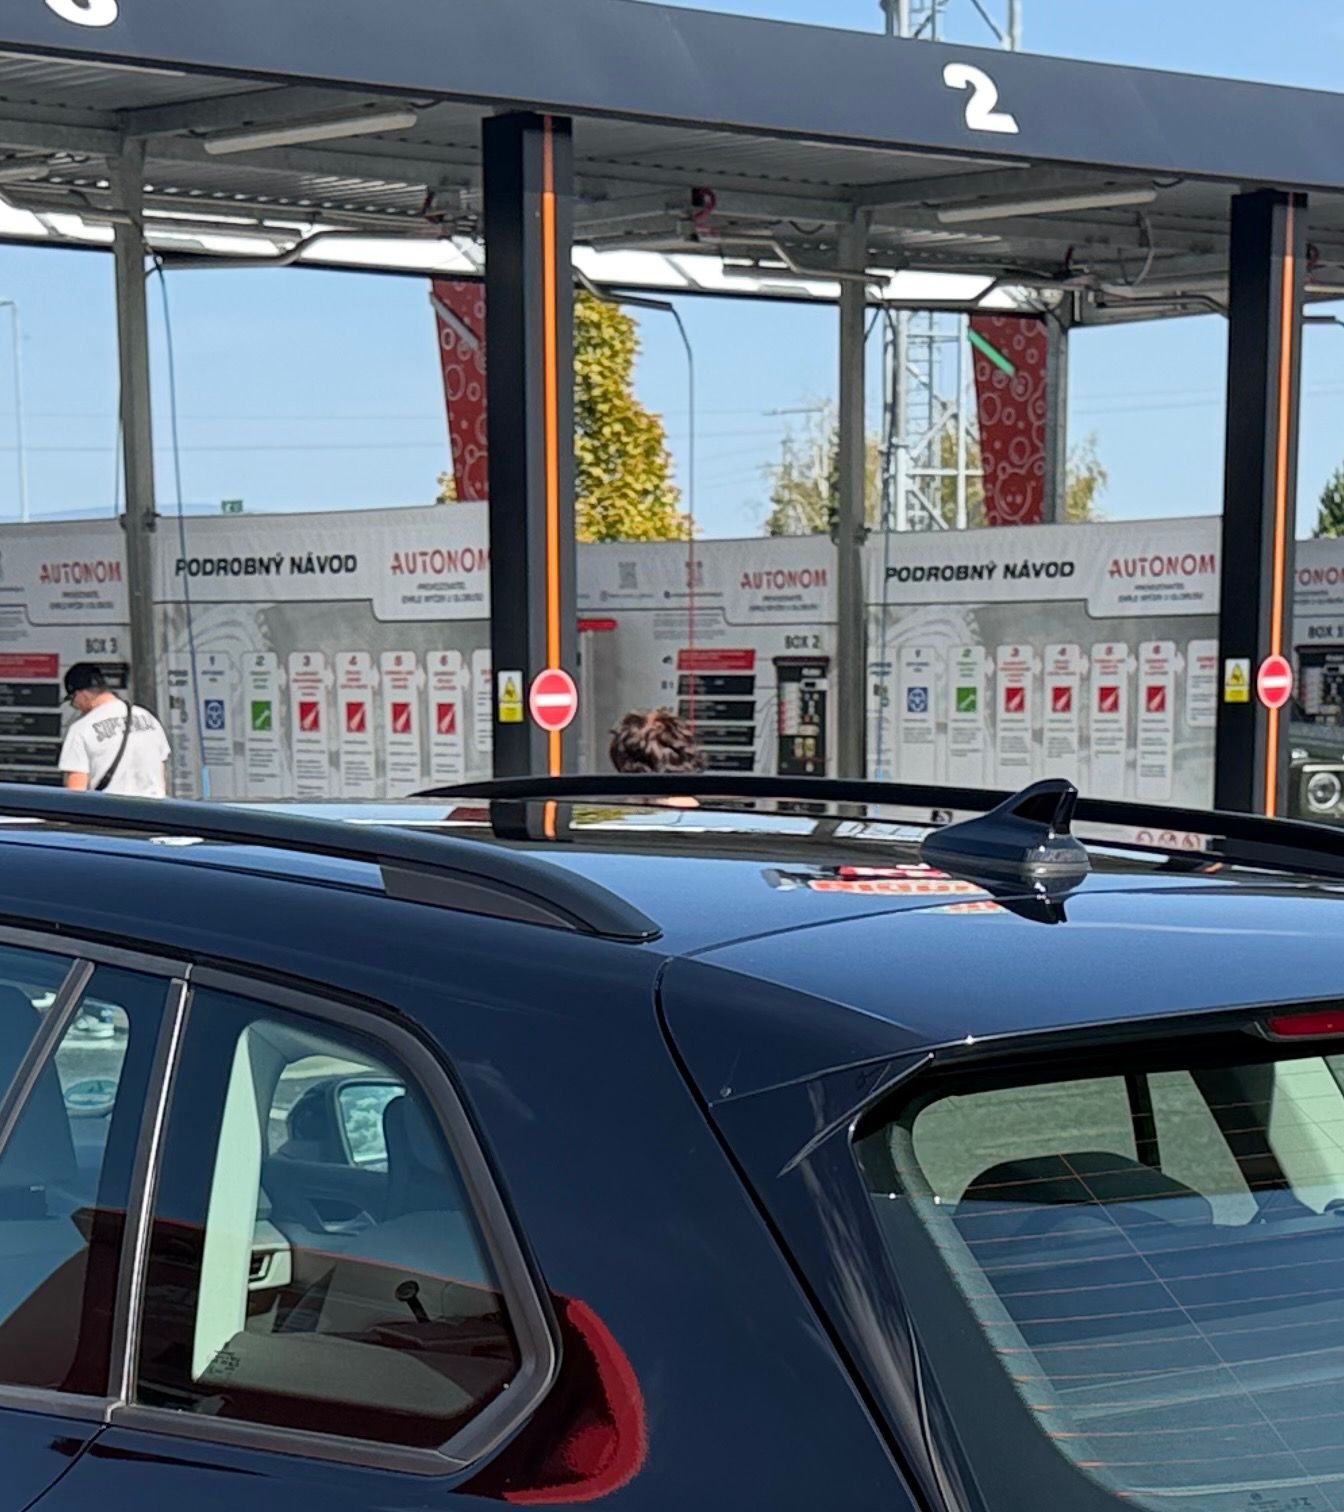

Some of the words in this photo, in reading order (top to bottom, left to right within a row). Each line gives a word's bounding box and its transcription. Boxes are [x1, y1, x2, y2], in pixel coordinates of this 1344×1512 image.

[943, 63, 1019, 133] 2
[40, 561, 122, 584] AUTONOM
[175, 552, 284, 577] PODROBNÝ
[290, 552, 357, 575] NÁVOD
[391, 548, 491, 575] AUTONOM
[885, 560, 996, 583] PODROBNÝ
[1003, 560, 1075, 580] NÁVOD
[1108, 553, 1216, 579] AUTONOM
[741, 568, 828, 591] AUTONOM
